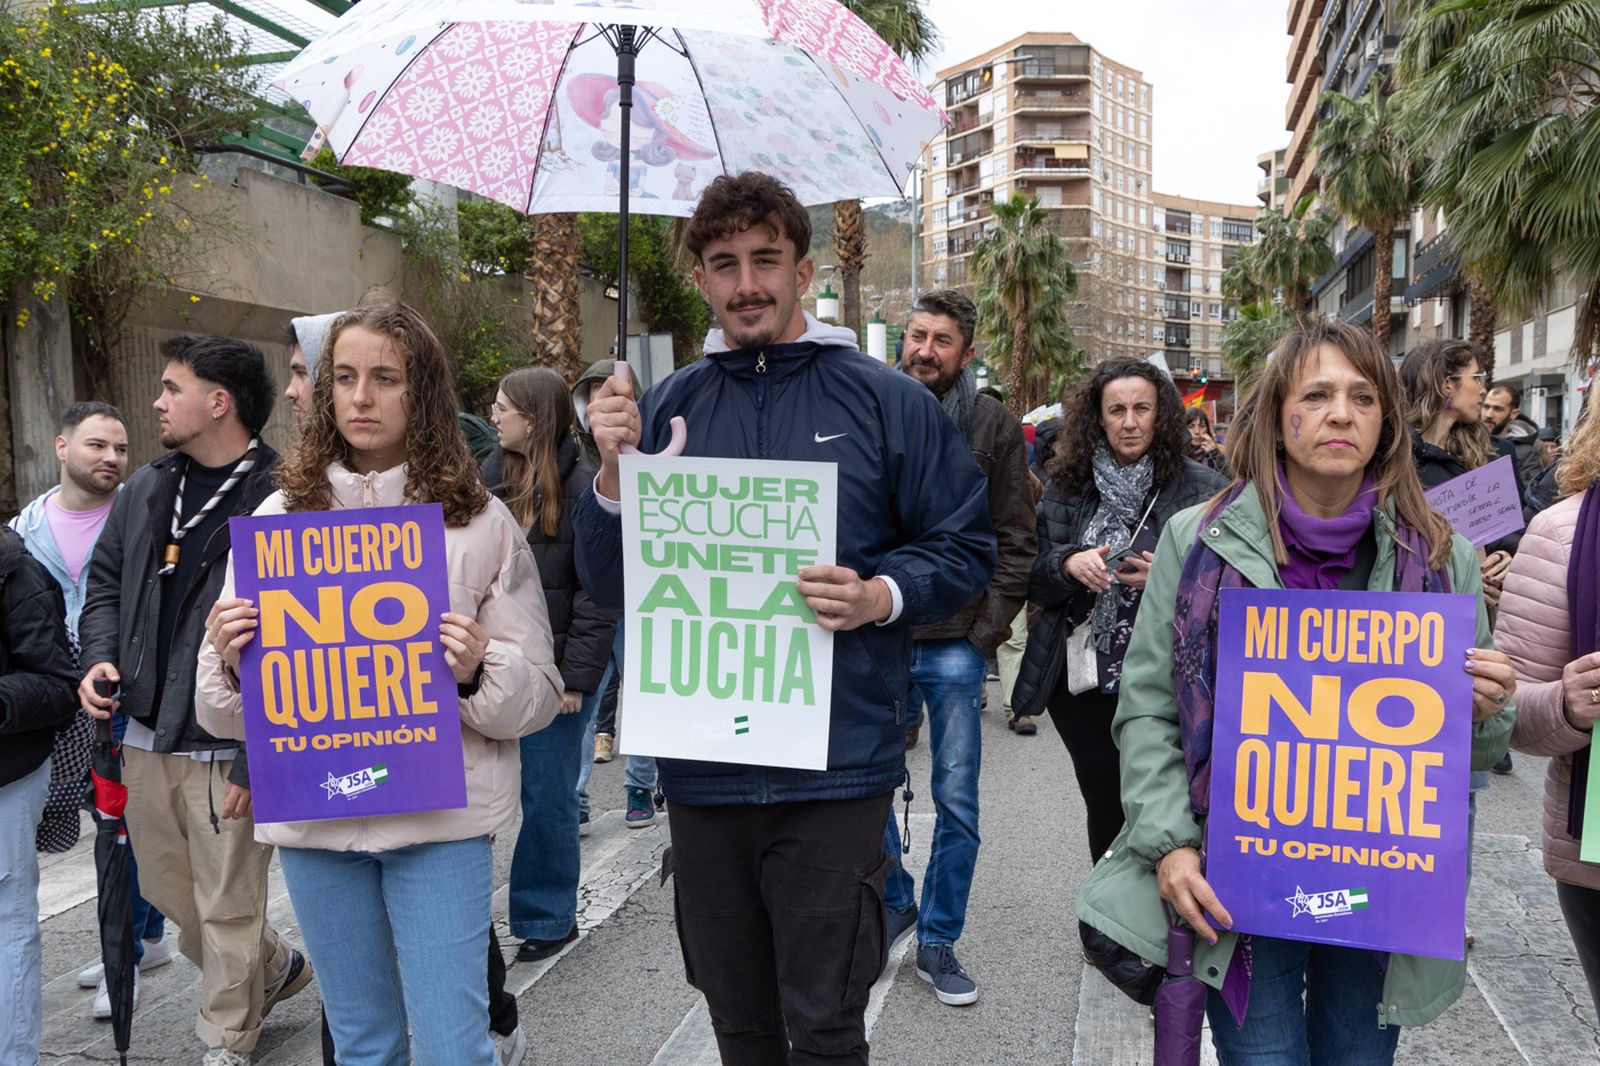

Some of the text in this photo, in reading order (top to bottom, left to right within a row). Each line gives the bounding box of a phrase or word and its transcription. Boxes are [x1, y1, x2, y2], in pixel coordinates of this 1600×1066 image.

[637, 471, 819, 504] MUJER
[1430, 489, 1455, 507] ASTA
[638, 498, 821, 542] ESCUCHA
[254, 520, 423, 579] MI CUERPO
[640, 528, 818, 576] ÚNETE
[258, 581, 430, 648] NO
[636, 573, 818, 625] A LA
[639, 616, 816, 706] LUCHA
[1244, 605, 1444, 667] MI CUERPO
[260, 641, 439, 729] QUIERE
[1240, 671, 1446, 746] NO
[269, 724, 437, 753] TU OPINIÓN
[346, 770, 371, 789] JSA
[1234, 738, 1444, 839] QUIERE
[1234, 835, 1435, 873] TU OPINIÓN
[1317, 891, 1348, 909] JSA
